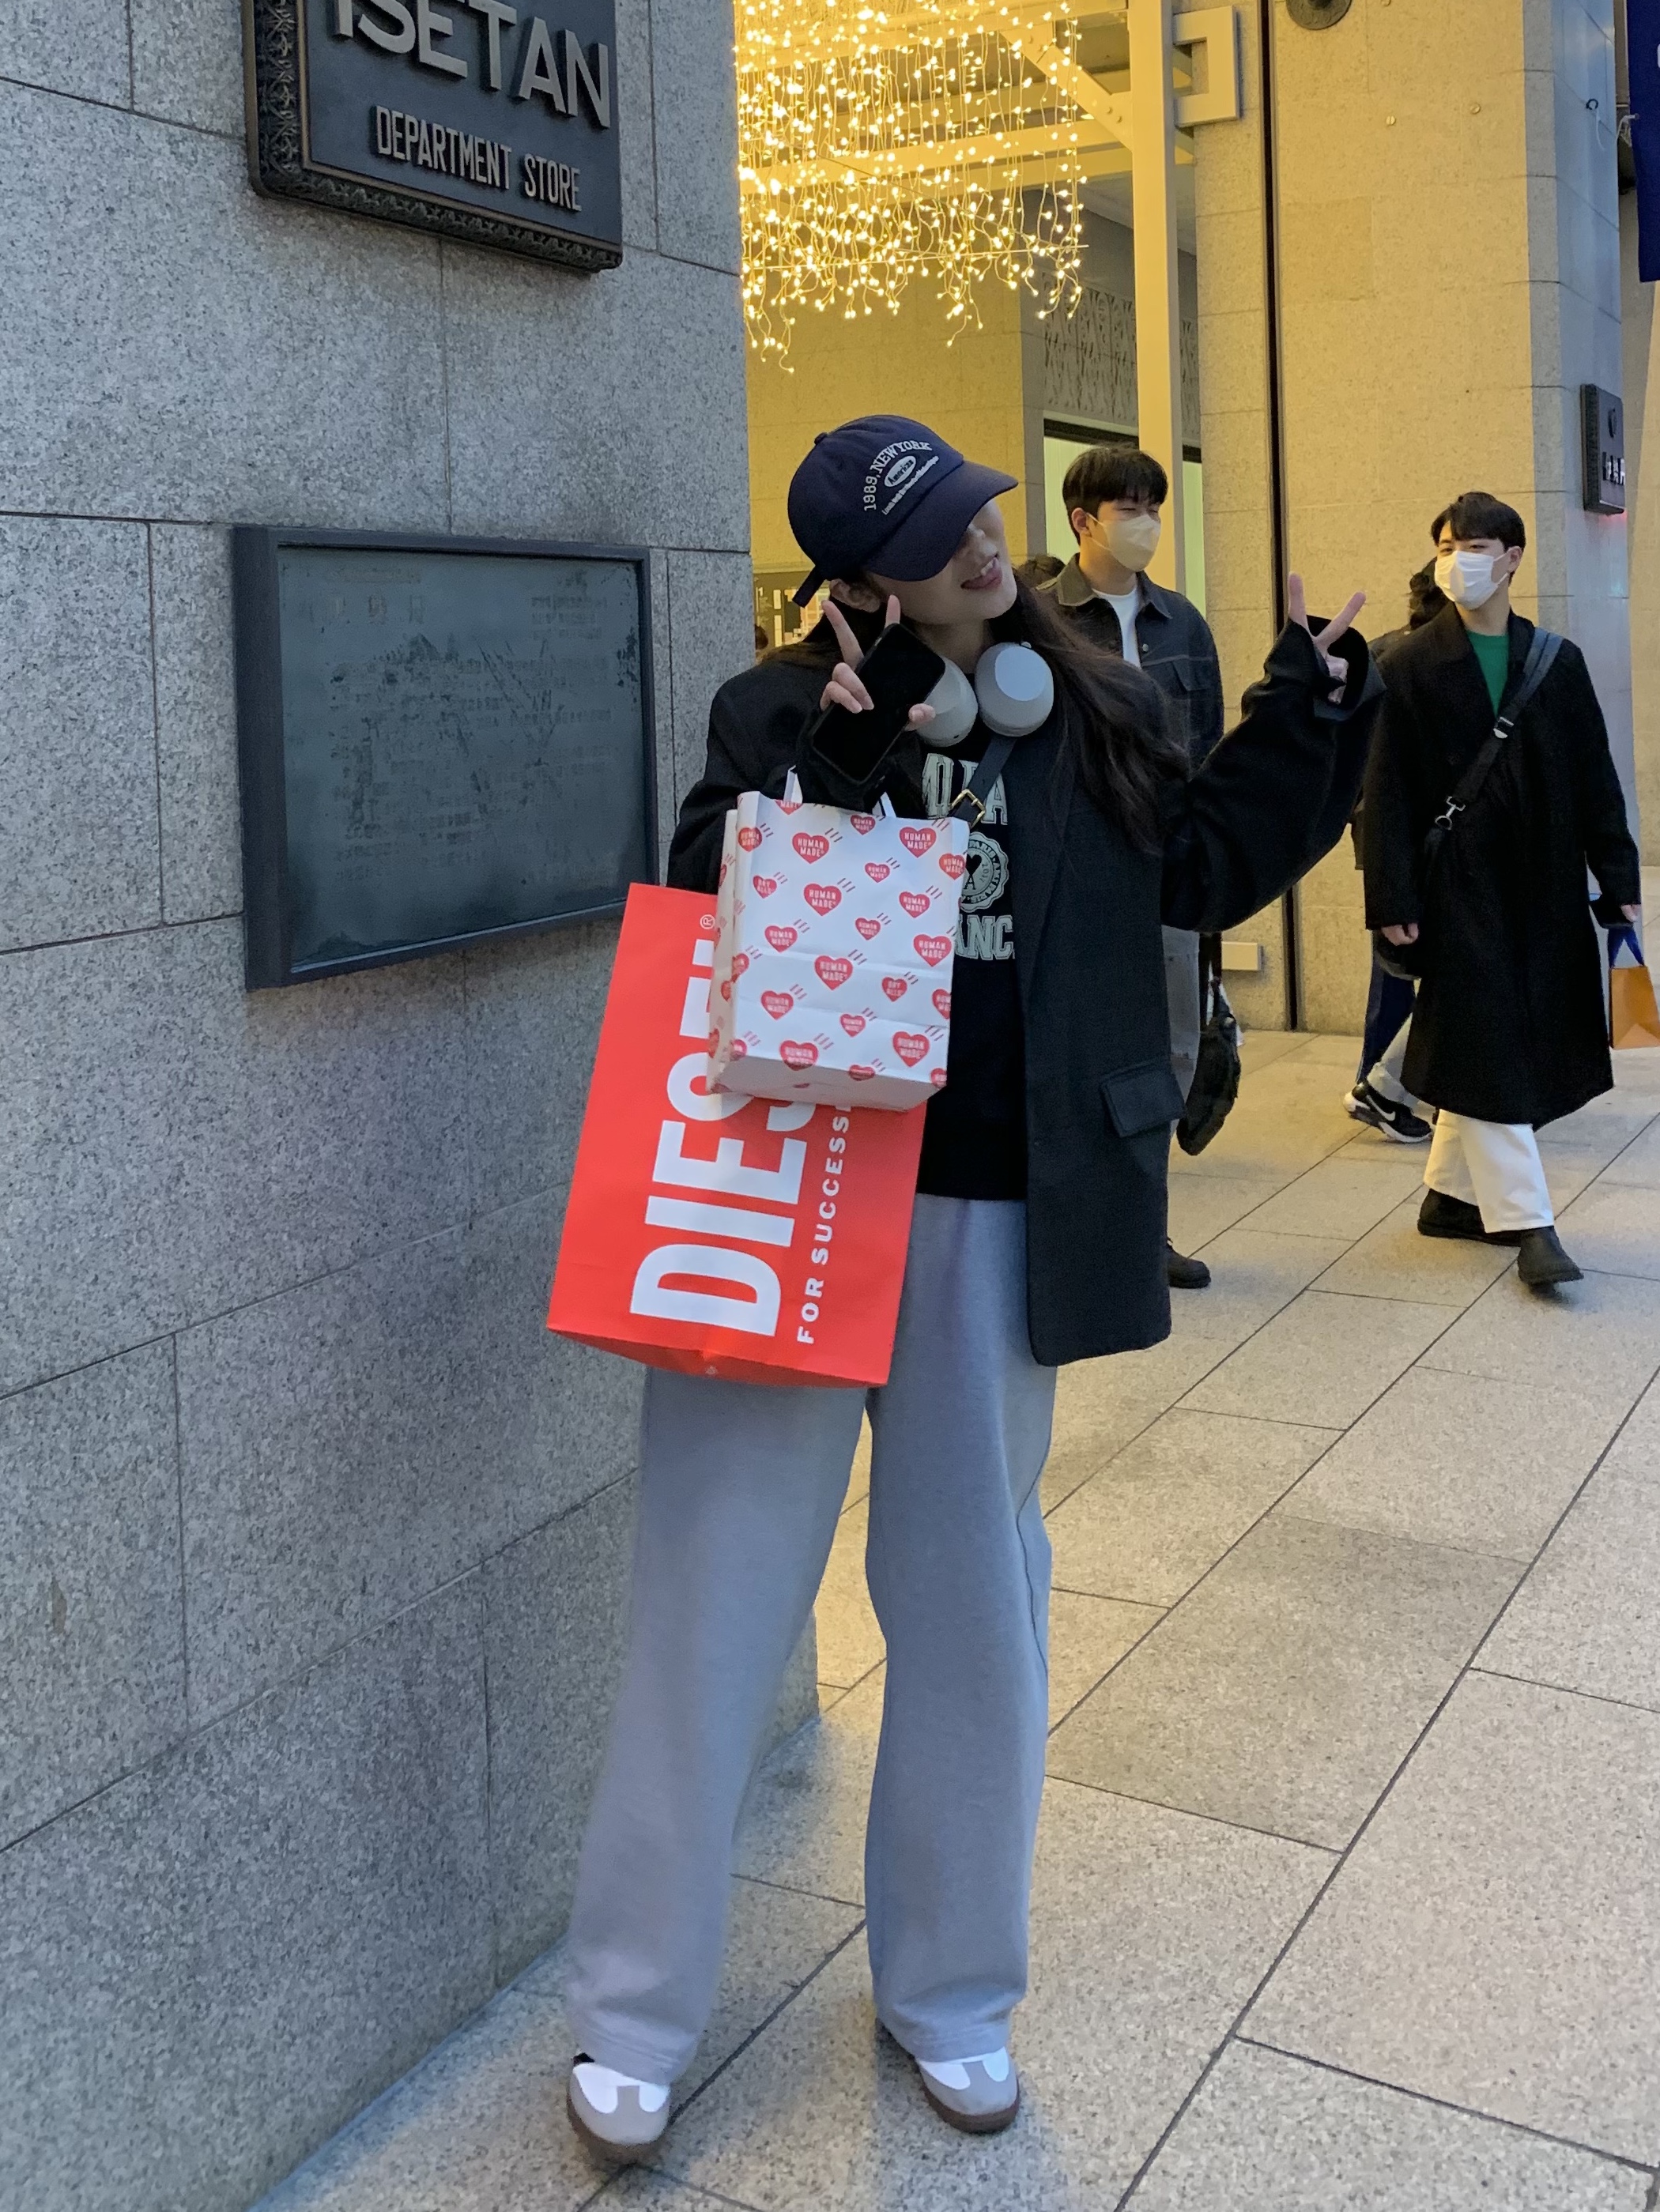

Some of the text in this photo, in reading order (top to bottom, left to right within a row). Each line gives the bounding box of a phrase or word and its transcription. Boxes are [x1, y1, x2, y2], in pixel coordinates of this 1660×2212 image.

[374, 104, 582, 213] DEPARTMENT STORE
[904, 832, 930, 841] HUMAN
[798, 838, 824, 849] HUMAN
[809, 889, 836, 900] HUMAN
[820, 961, 847, 973] HUMAN
[630, 938, 818, 1336] DIES
[797, 1106, 851, 1344] FOR SUCCESS
